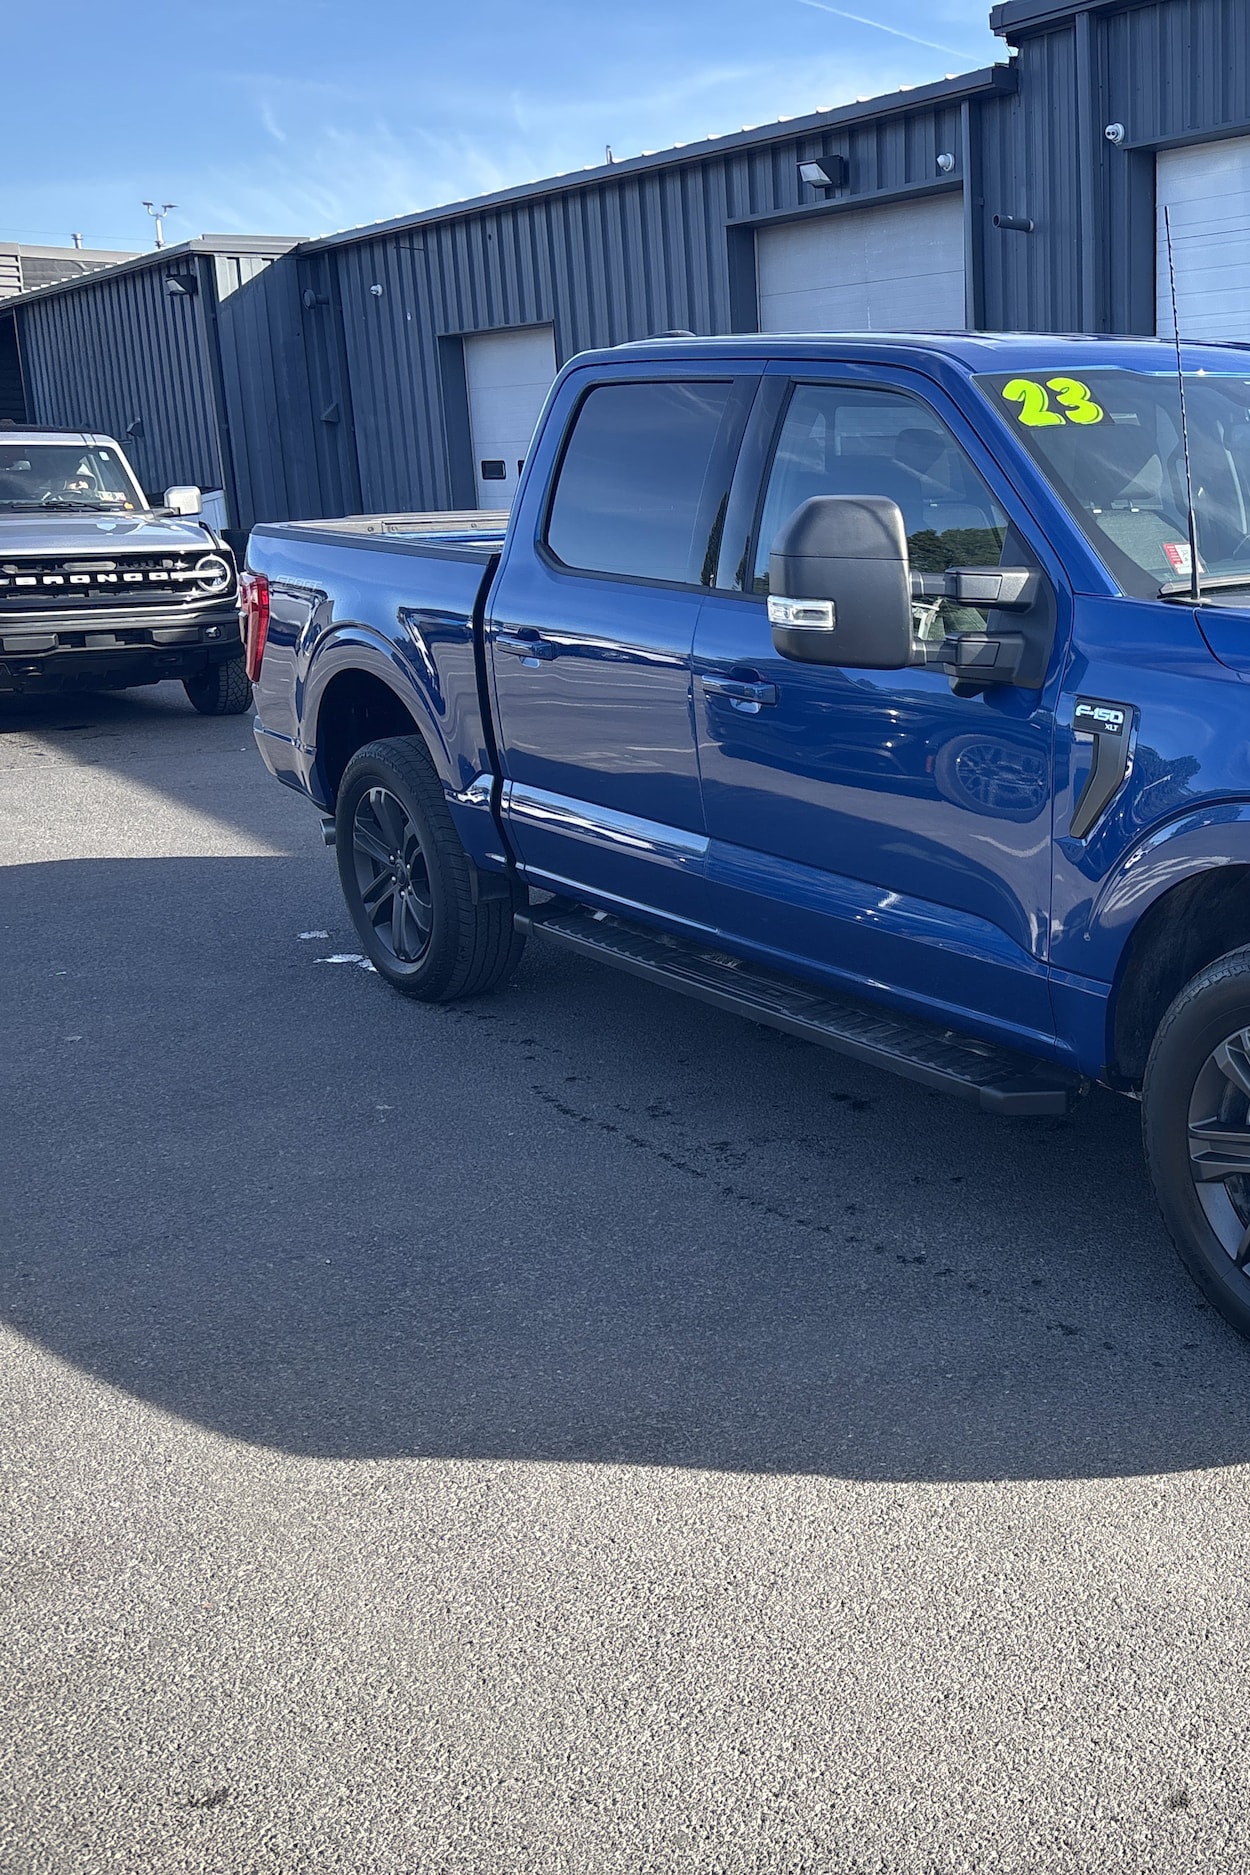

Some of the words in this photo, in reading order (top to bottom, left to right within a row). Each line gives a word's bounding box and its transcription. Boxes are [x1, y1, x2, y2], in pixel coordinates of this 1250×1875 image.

[1002, 377, 1104, 427] 23
[14, 570, 170, 587] BRONCO
[1075, 704, 1124, 724] F-150
[1104, 722, 1119, 732] XLT
